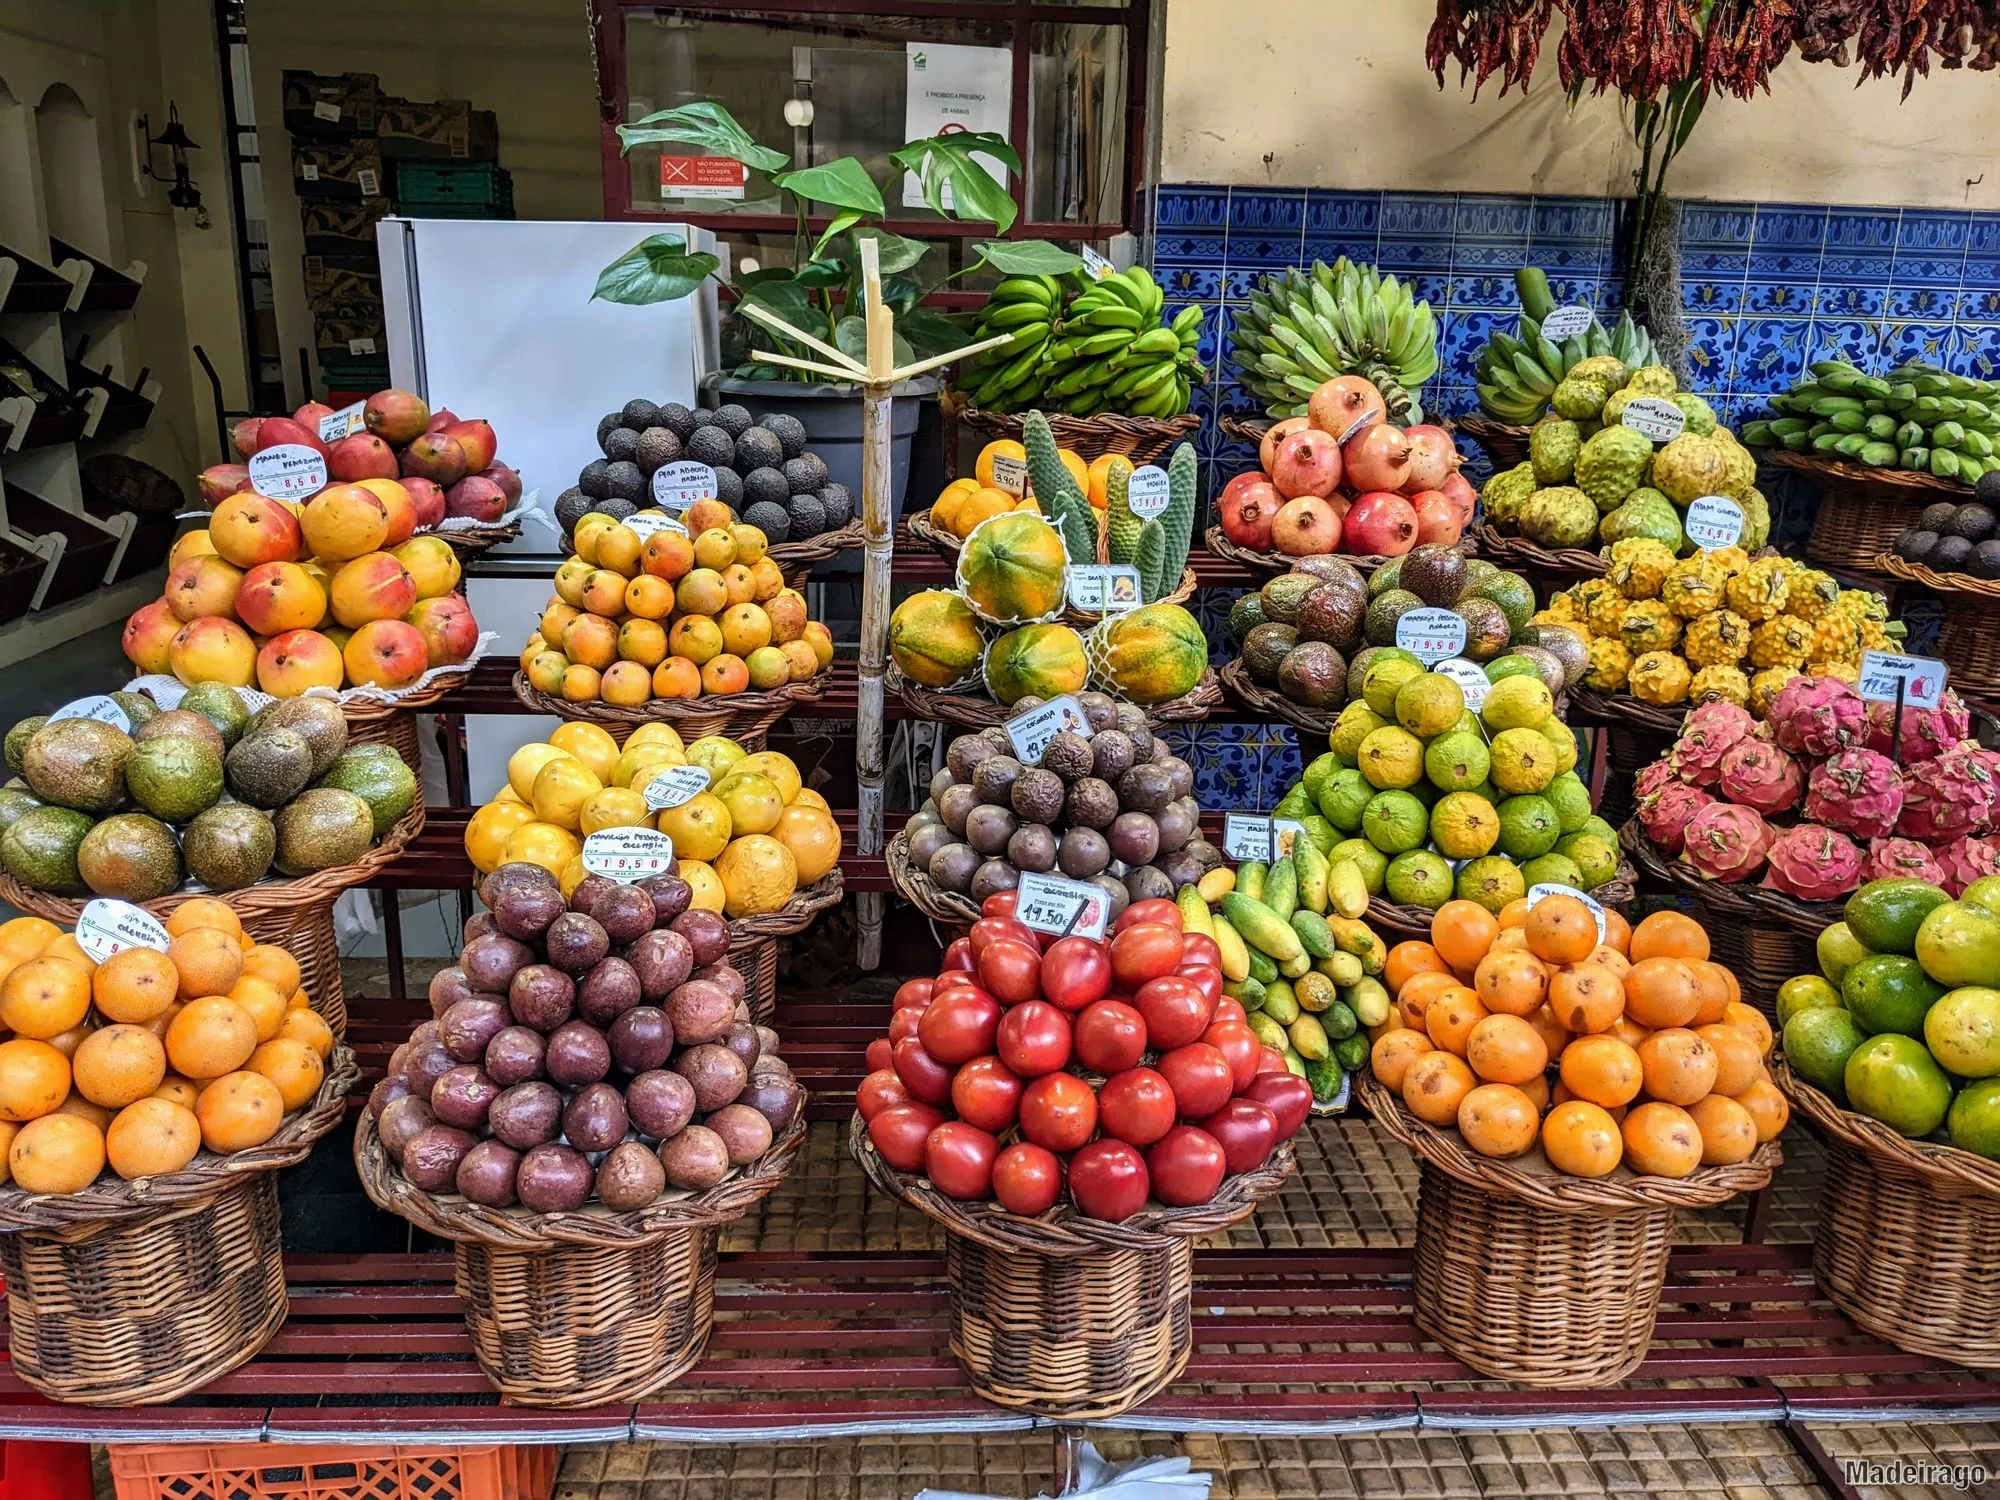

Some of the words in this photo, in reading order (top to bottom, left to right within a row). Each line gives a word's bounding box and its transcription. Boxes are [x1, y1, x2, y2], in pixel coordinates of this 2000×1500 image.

[959, 93, 986, 102] PRESENÇA
[950, 107, 970, 116] ANIMAIS
[284, 475, 318, 491] 8,50
[1411, 640, 1456, 652] 19,50
[1234, 842, 1269, 858] 19.50
[603, 859, 658, 871] 19,50
[1023, 903, 1064, 925] 19.50
